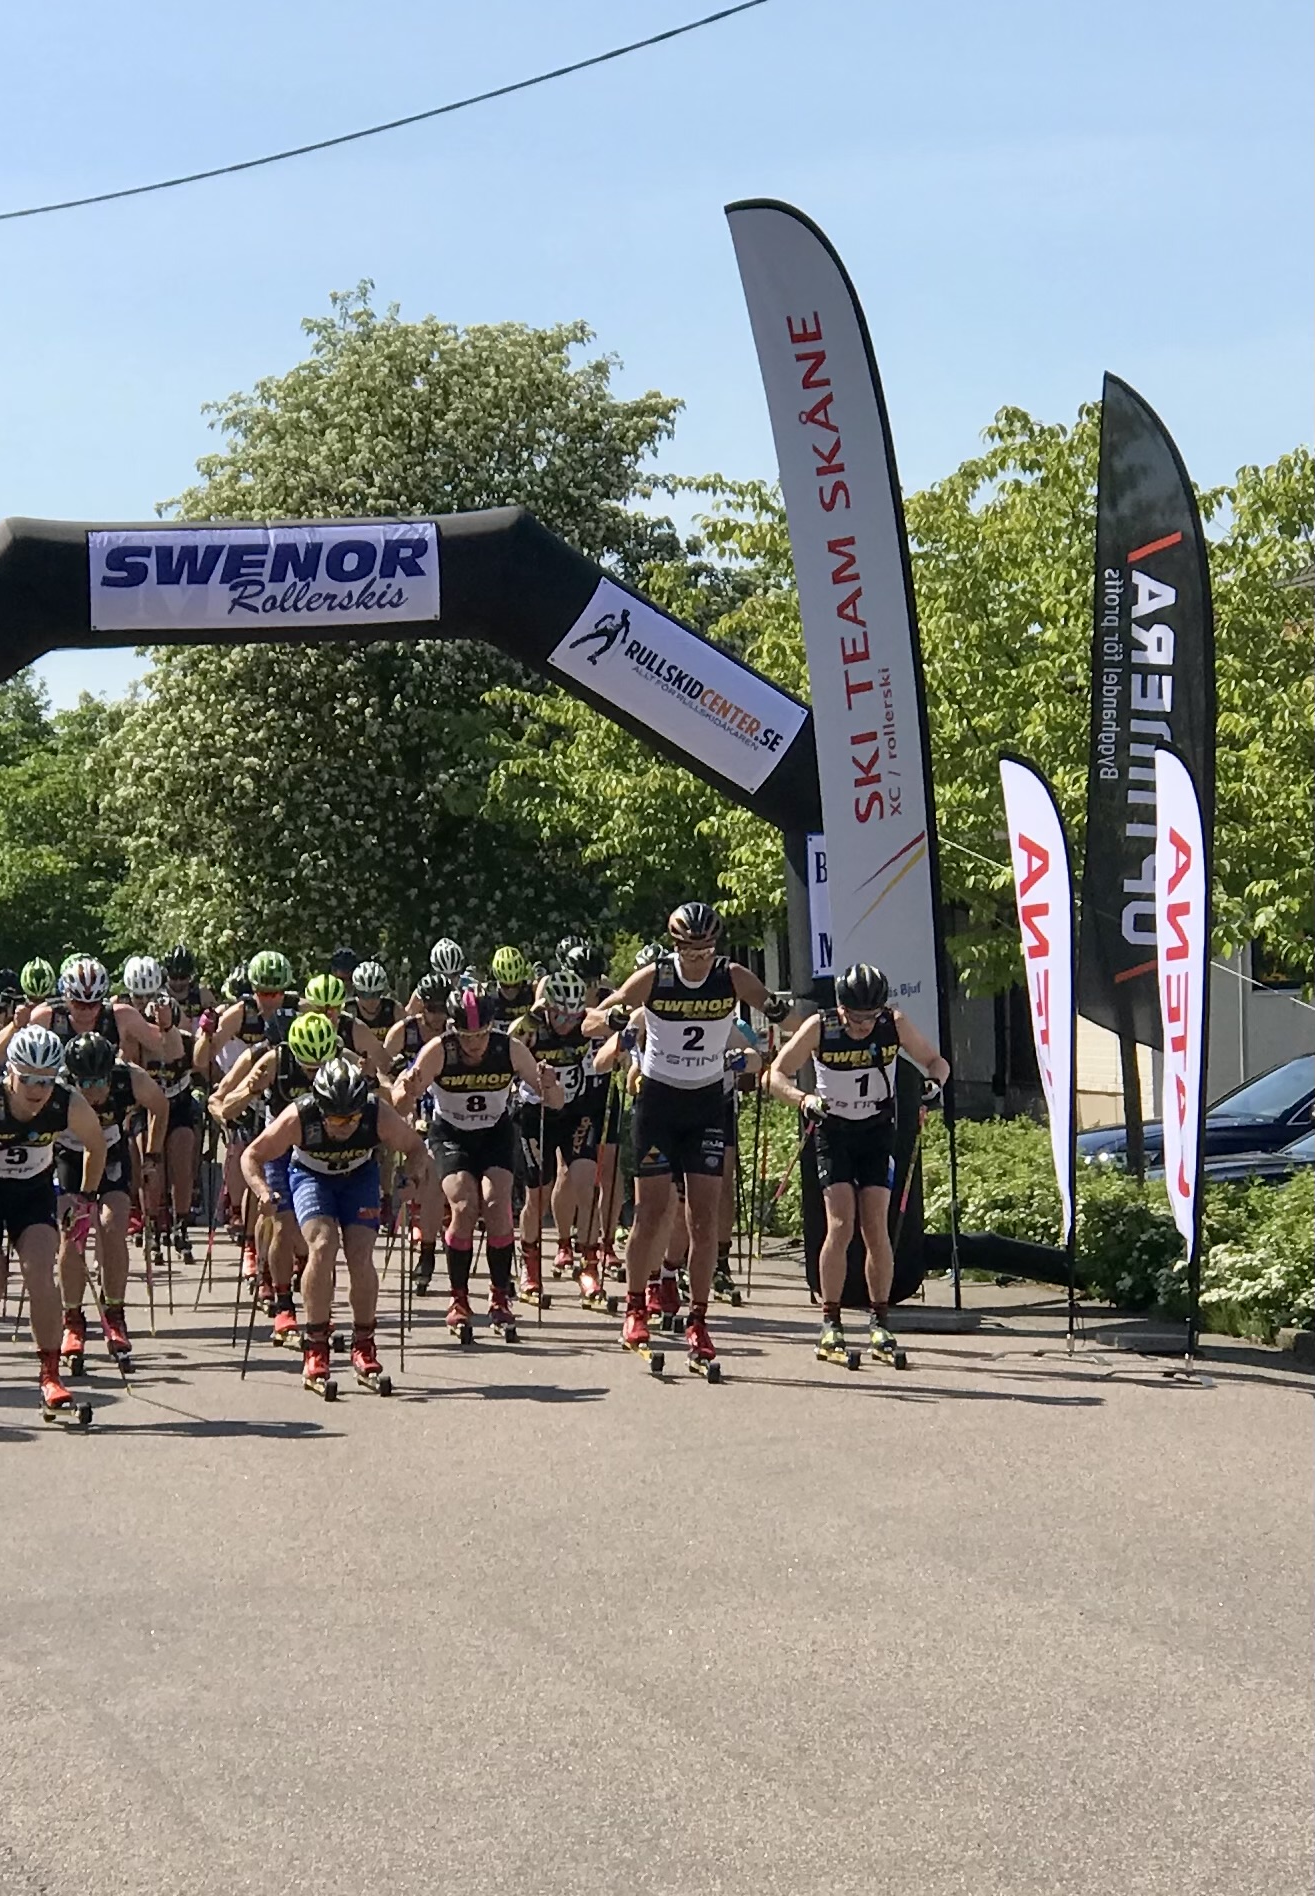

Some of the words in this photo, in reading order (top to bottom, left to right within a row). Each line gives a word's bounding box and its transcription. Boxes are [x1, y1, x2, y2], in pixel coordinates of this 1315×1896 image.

[786, 310, 851, 513] SKÅNE
[100, 537, 430, 588] SWENOR
[227, 576, 409, 615] Rollerskis
[827, 535, 875, 711] TEAM
[625, 639, 784, 753] RULLSKIDCENTER.SE
[879, 667, 898, 760] rollerski
[850, 731, 884, 825] SKI
[888, 781, 903, 817] XC
[682, 1026, 704, 1050] 2
[466, 1095, 487, 1112] 8
[855, 1073, 869, 1097] 1
